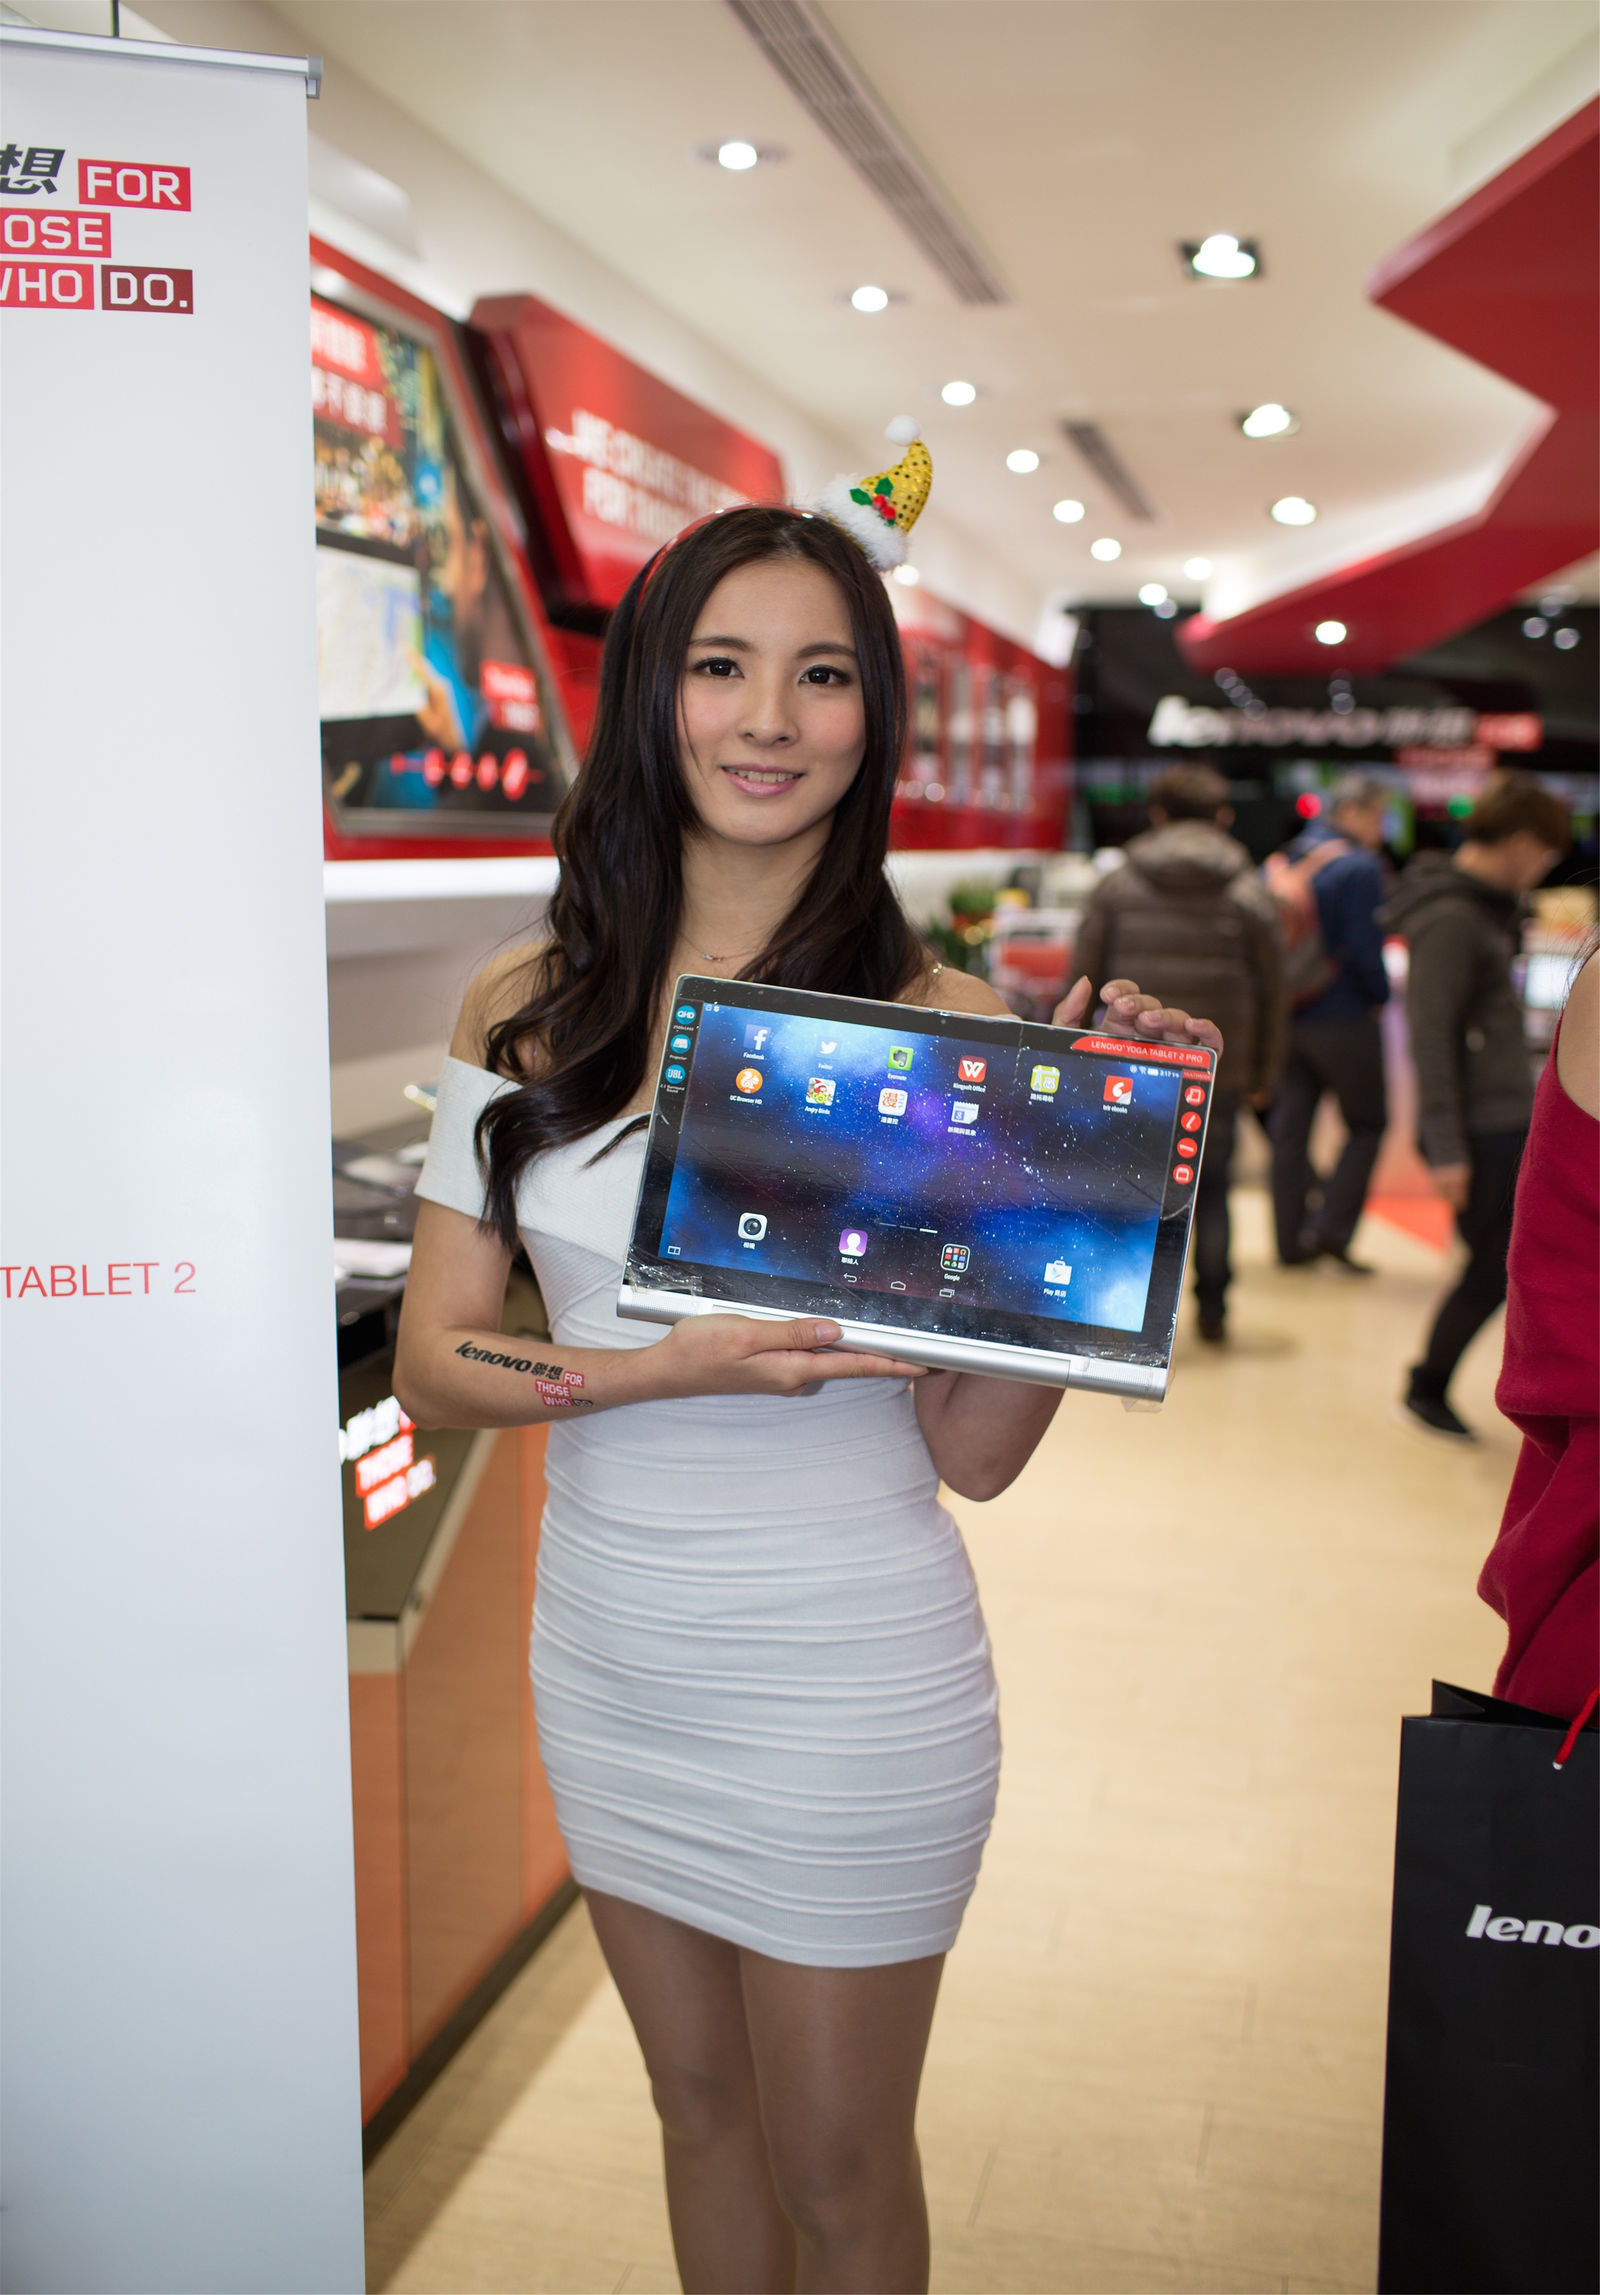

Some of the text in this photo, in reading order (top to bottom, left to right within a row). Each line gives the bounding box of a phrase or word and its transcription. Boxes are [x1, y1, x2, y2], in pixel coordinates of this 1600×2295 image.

[0, 143, 182, 205] 想 FOR
[3, 214, 104, 252] OSE
[109, 271, 188, 308] DO.
[1126, 1045, 1148, 1056] YOGA
[1149, 1048, 1178, 1060] TABLET
[1186, 1053, 1203, 1063] PRO
[0, 1262, 197, 1299] TABLET 2
[943, 1273, 961, 1282] Google
[454, 1340, 532, 1373] lenovo
[564, 1372, 583, 1387] FOR
[536, 1380, 571, 1397] THOSE
[543, 1395, 572, 1407] WHO
[1465, 1903, 1600, 1949] leno
